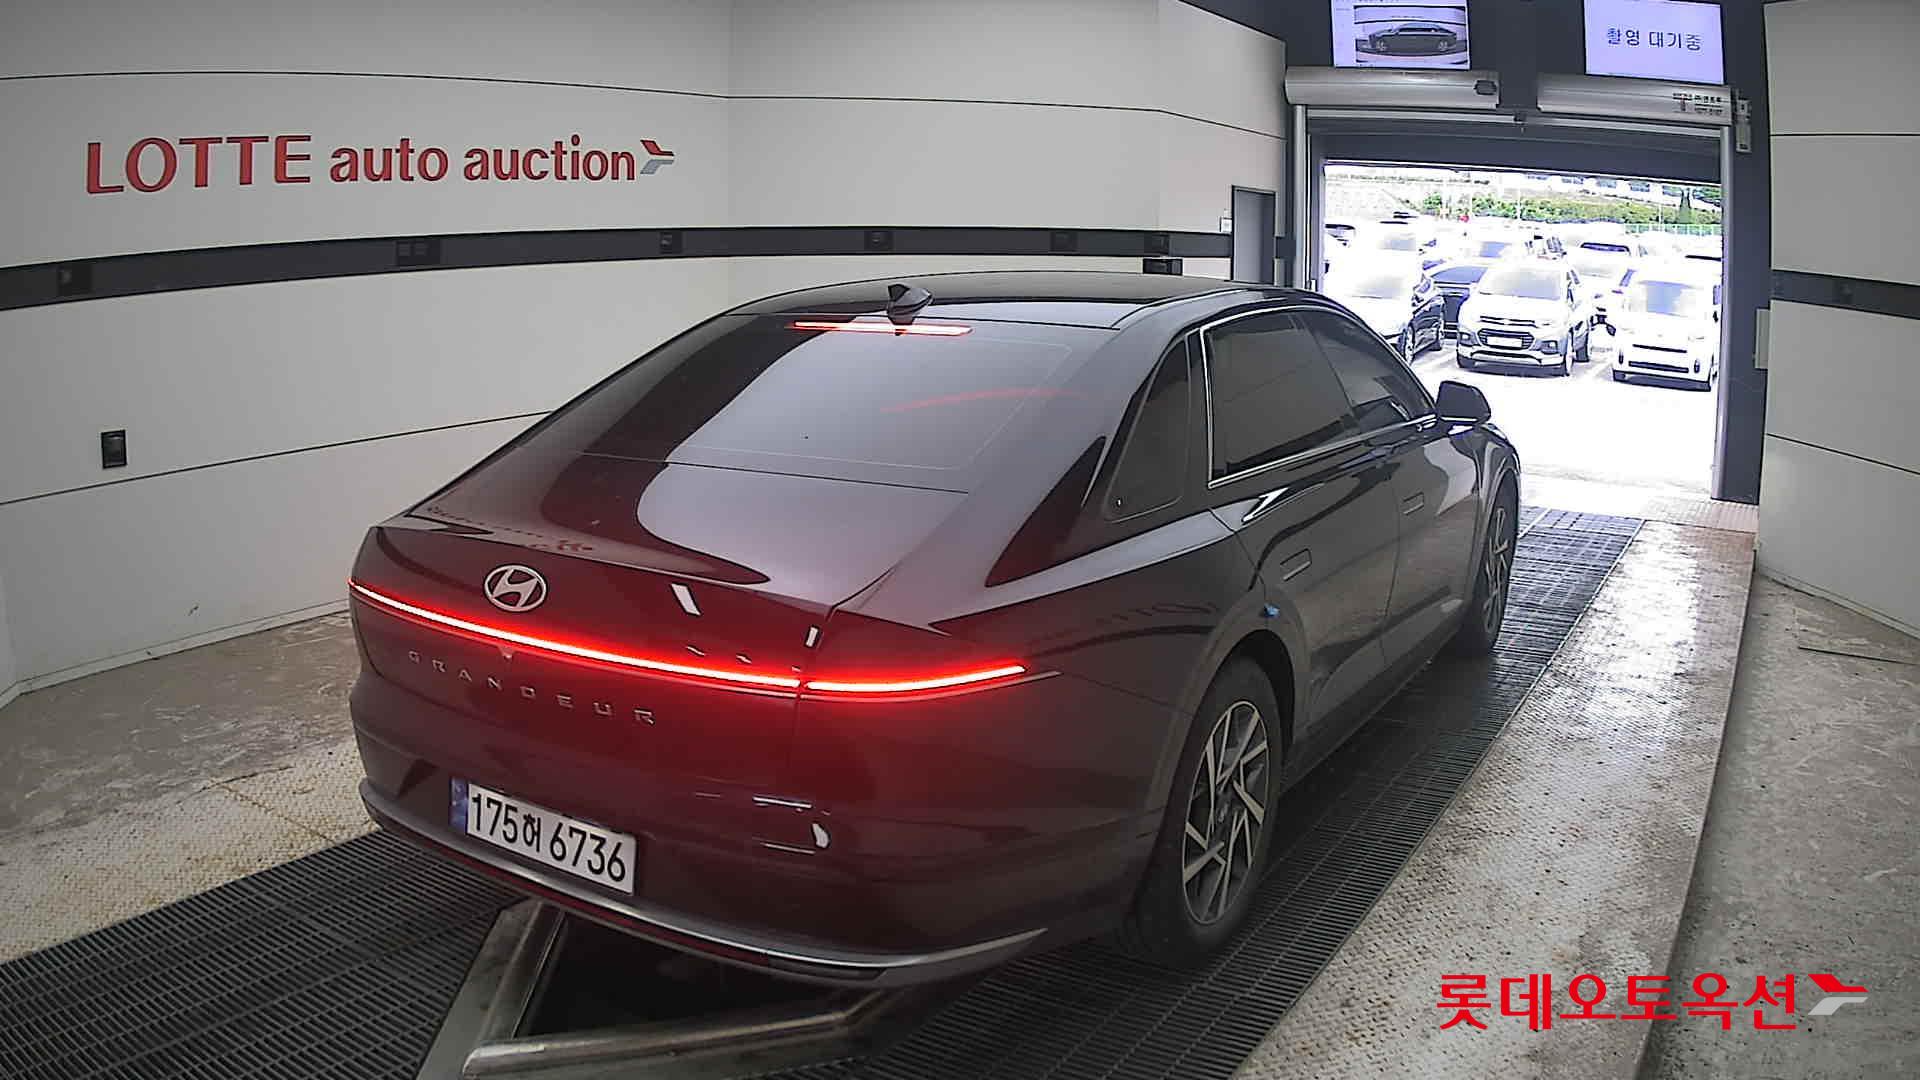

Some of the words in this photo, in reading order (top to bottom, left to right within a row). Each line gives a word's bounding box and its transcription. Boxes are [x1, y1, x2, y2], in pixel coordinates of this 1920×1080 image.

[1648, 32, 1701, 51] 대기중
[87, 135, 311, 194] LOTTE
[329, 138, 449, 182] auto
[463, 134, 635, 181] auction
[408, 650, 655, 725] GRANDEUR
